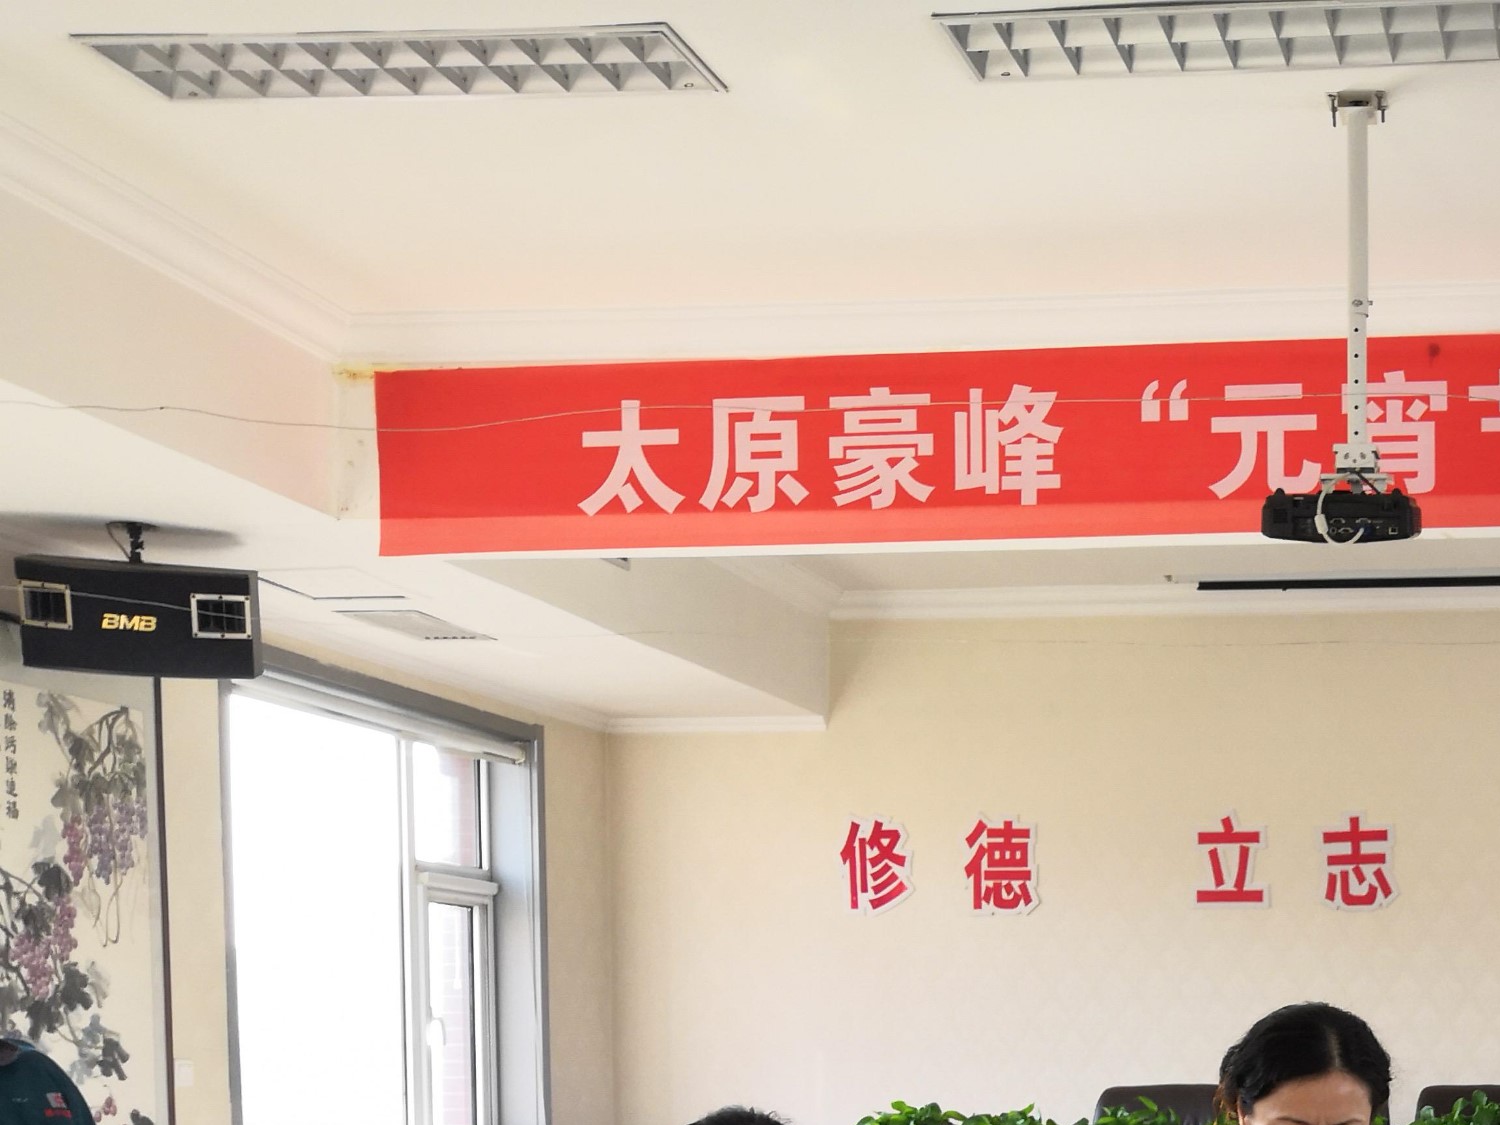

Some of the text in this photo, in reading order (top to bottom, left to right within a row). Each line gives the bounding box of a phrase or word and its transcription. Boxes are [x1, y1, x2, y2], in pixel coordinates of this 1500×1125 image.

[577, 379, 1065, 517] 太原豪峰
[102, 613, 157, 632] BMB
[840, 819, 1032, 911] 修德
[1196, 815, 1393, 906] 立志
